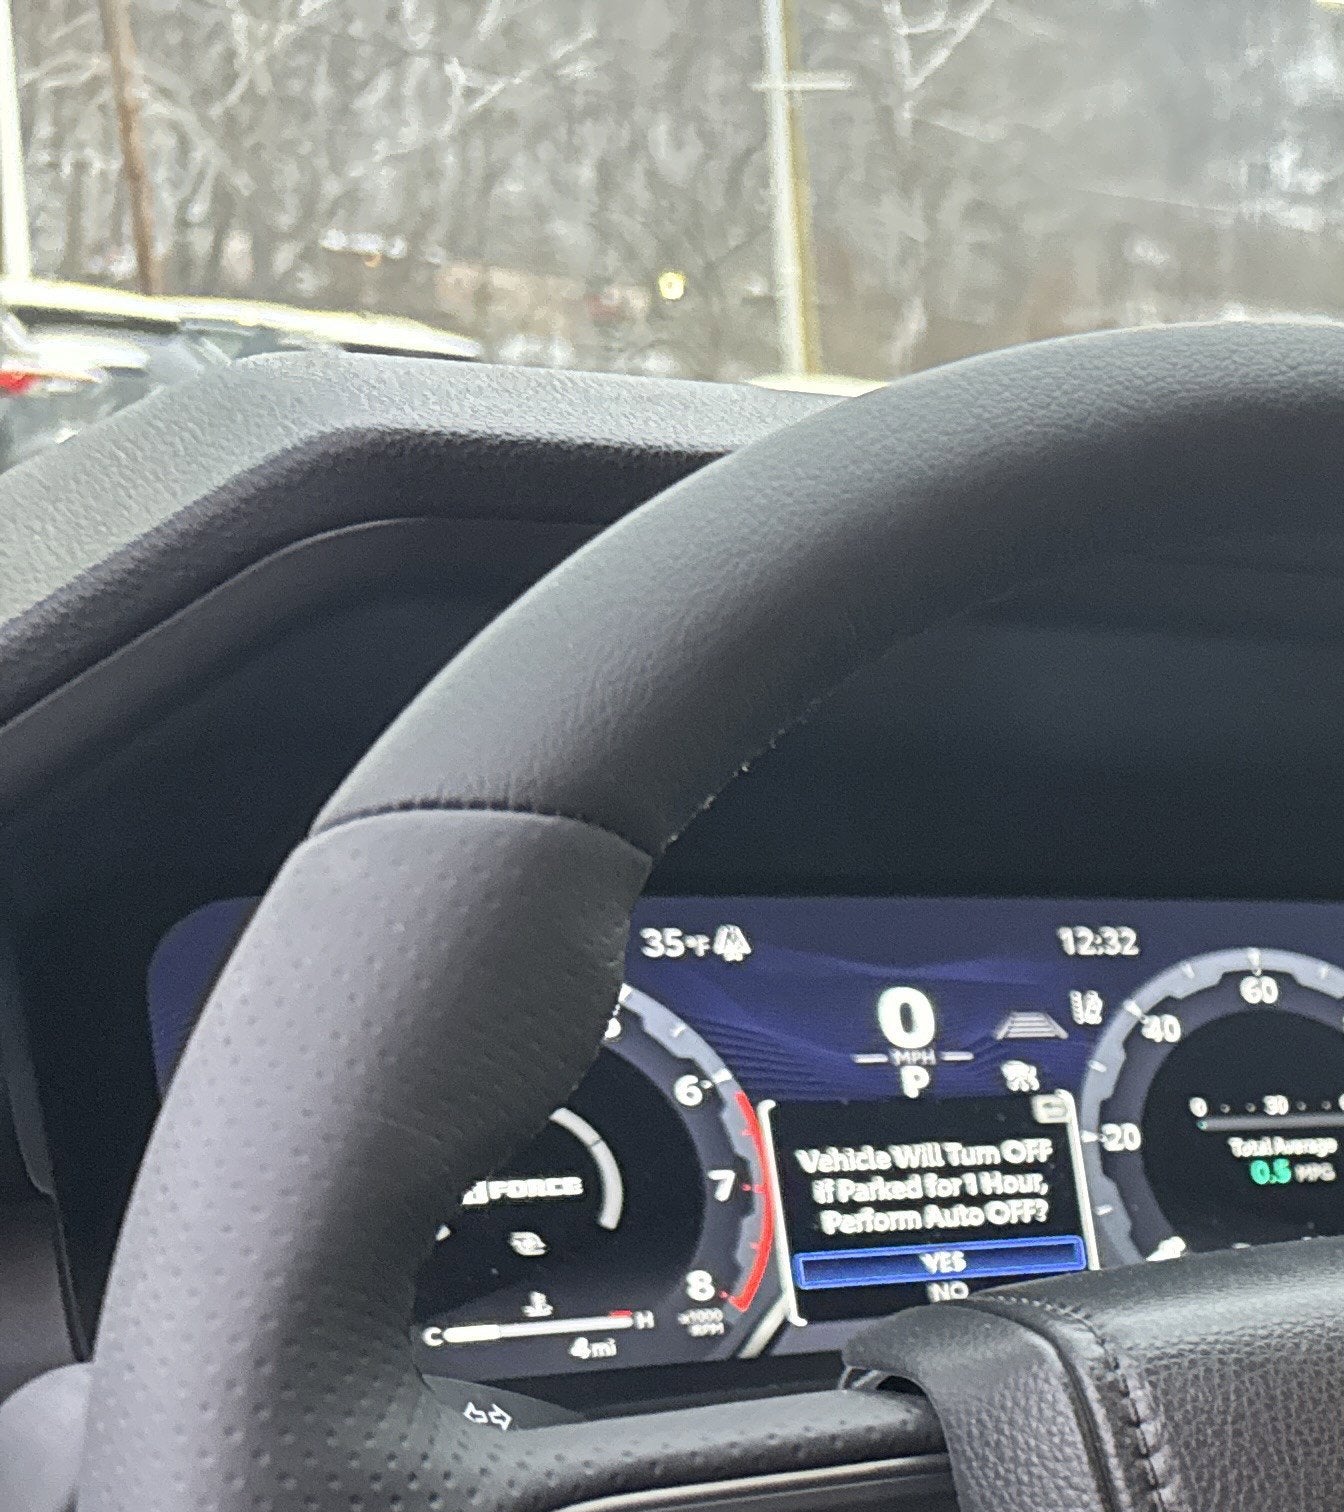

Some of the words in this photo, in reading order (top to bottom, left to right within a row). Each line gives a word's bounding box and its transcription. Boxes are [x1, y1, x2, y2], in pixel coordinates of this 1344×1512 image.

[1057, 925, 1140, 957] 12:32
[1239, 976, 1279, 1005] 60
[877, 985, 937, 1050] 0
[1142, 1014, 1182, 1043] 40
[673, 1074, 704, 1107] 6
[901, 1066, 931, 1099] P
[1102, 1122, 1142, 1152] 20
[1227, 1135, 1273, 1158] Total
[1273, 1135, 1339, 1158] Average
[795, 1144, 892, 1174] Vehicle
[889, 1141, 946, 1170] Will
[942, 1141, 1001, 1168] Turn
[1001, 1137, 1054, 1165] OFF
[708, 1168, 736, 1203] 7
[836, 1175, 924, 1204] Parked
[922, 1171, 963, 1199] for
[962, 1171, 979, 1197] 1
[978, 1169, 1049, 1197] Hour,
[1249, 1157, 1293, 1186] 0.5
[820, 1205, 923, 1236] Perform
[922, 1202, 986, 1230] Auto
[984, 1197, 1050, 1226] OFF?
[919, 1250, 968, 1275] YES
[685, 1269, 717, 1302] 8
[925, 1280, 971, 1303] NO
[634, 1310, 655, 1330] H
[422, 1327, 446, 1348] C
